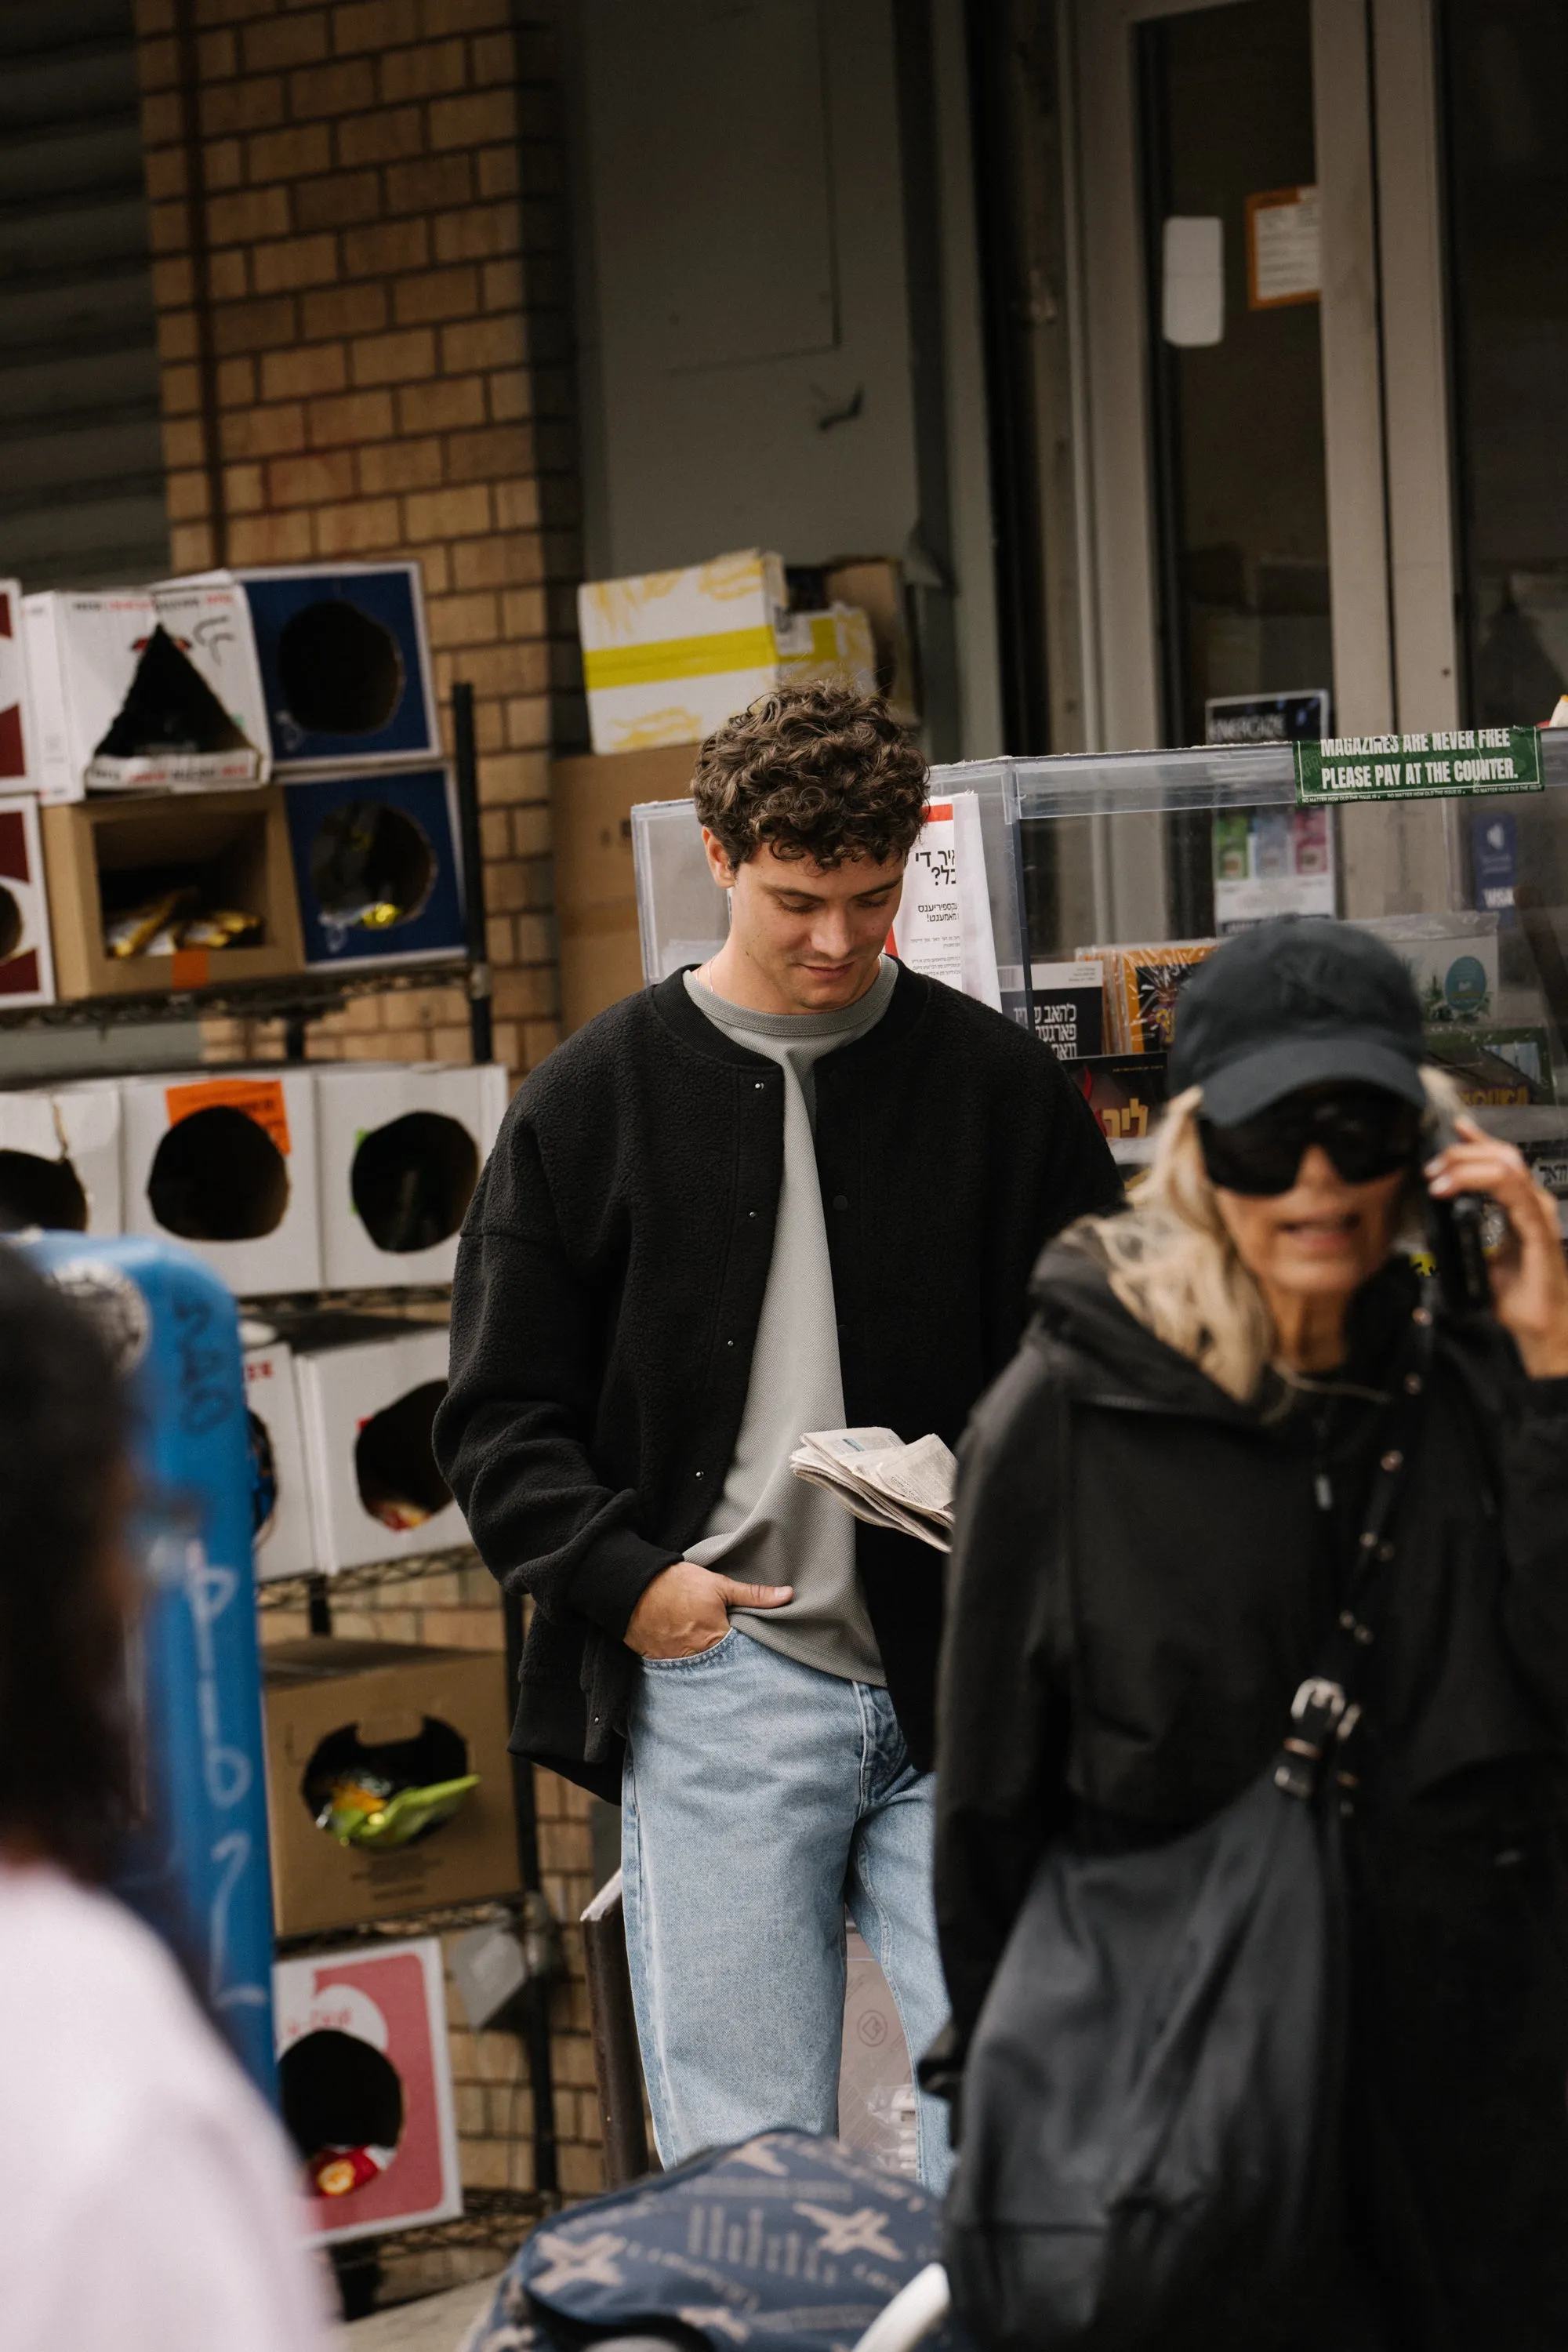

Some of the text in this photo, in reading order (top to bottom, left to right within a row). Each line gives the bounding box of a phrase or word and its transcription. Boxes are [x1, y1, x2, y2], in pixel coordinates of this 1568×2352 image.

[1321, 728, 1510, 757] MAGAZINES ARE NEVER FREE
[1321, 757, 1519, 789] PLEASE PAY AT THE COUNTER.
[915, 851, 931, 867] די
